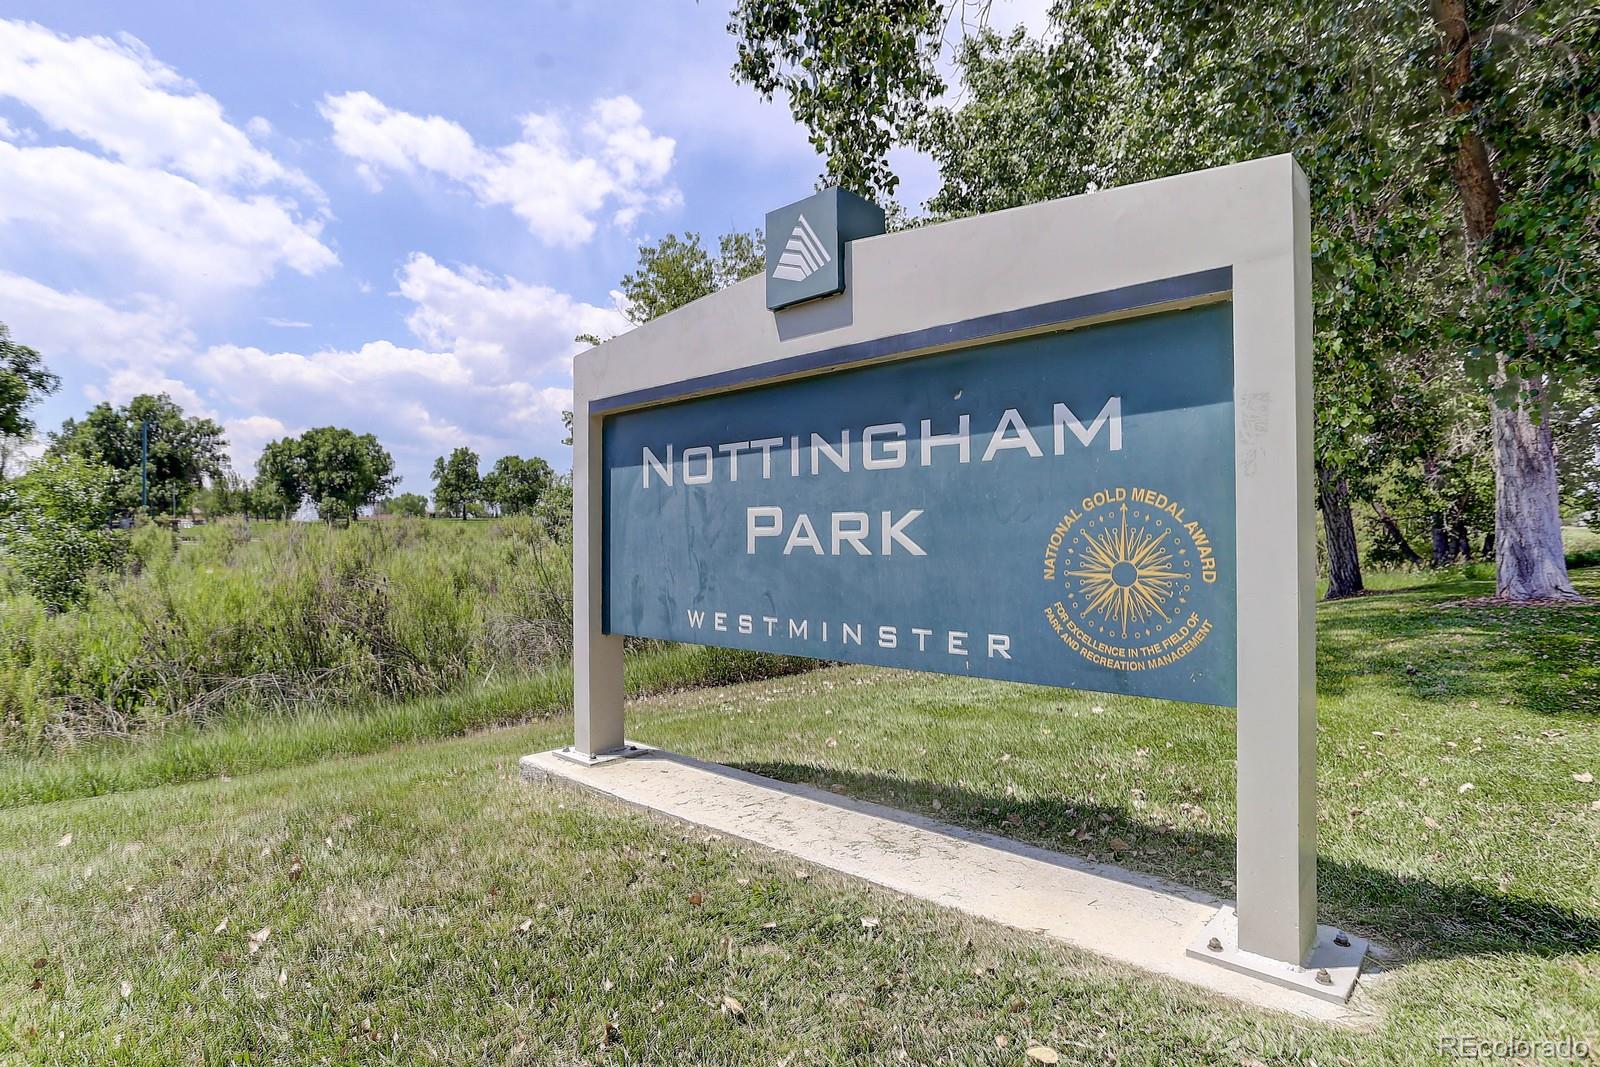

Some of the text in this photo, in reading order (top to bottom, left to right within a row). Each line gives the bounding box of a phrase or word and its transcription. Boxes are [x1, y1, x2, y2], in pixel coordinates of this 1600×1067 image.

[641, 396, 1123, 489] NOTTINGHAM
[746, 506, 927, 556] PARK
[1043, 487, 1217, 584] NATIONAL GOLD MEDAL AWARD
[687, 608, 1011, 659] WESTMINSTER
[1044, 607, 1214, 671] PARK AND RECREATION MANAGEMENT
[1053, 601, 1201, 658] FOR EXCELLENCE IN THE FIELD OF
